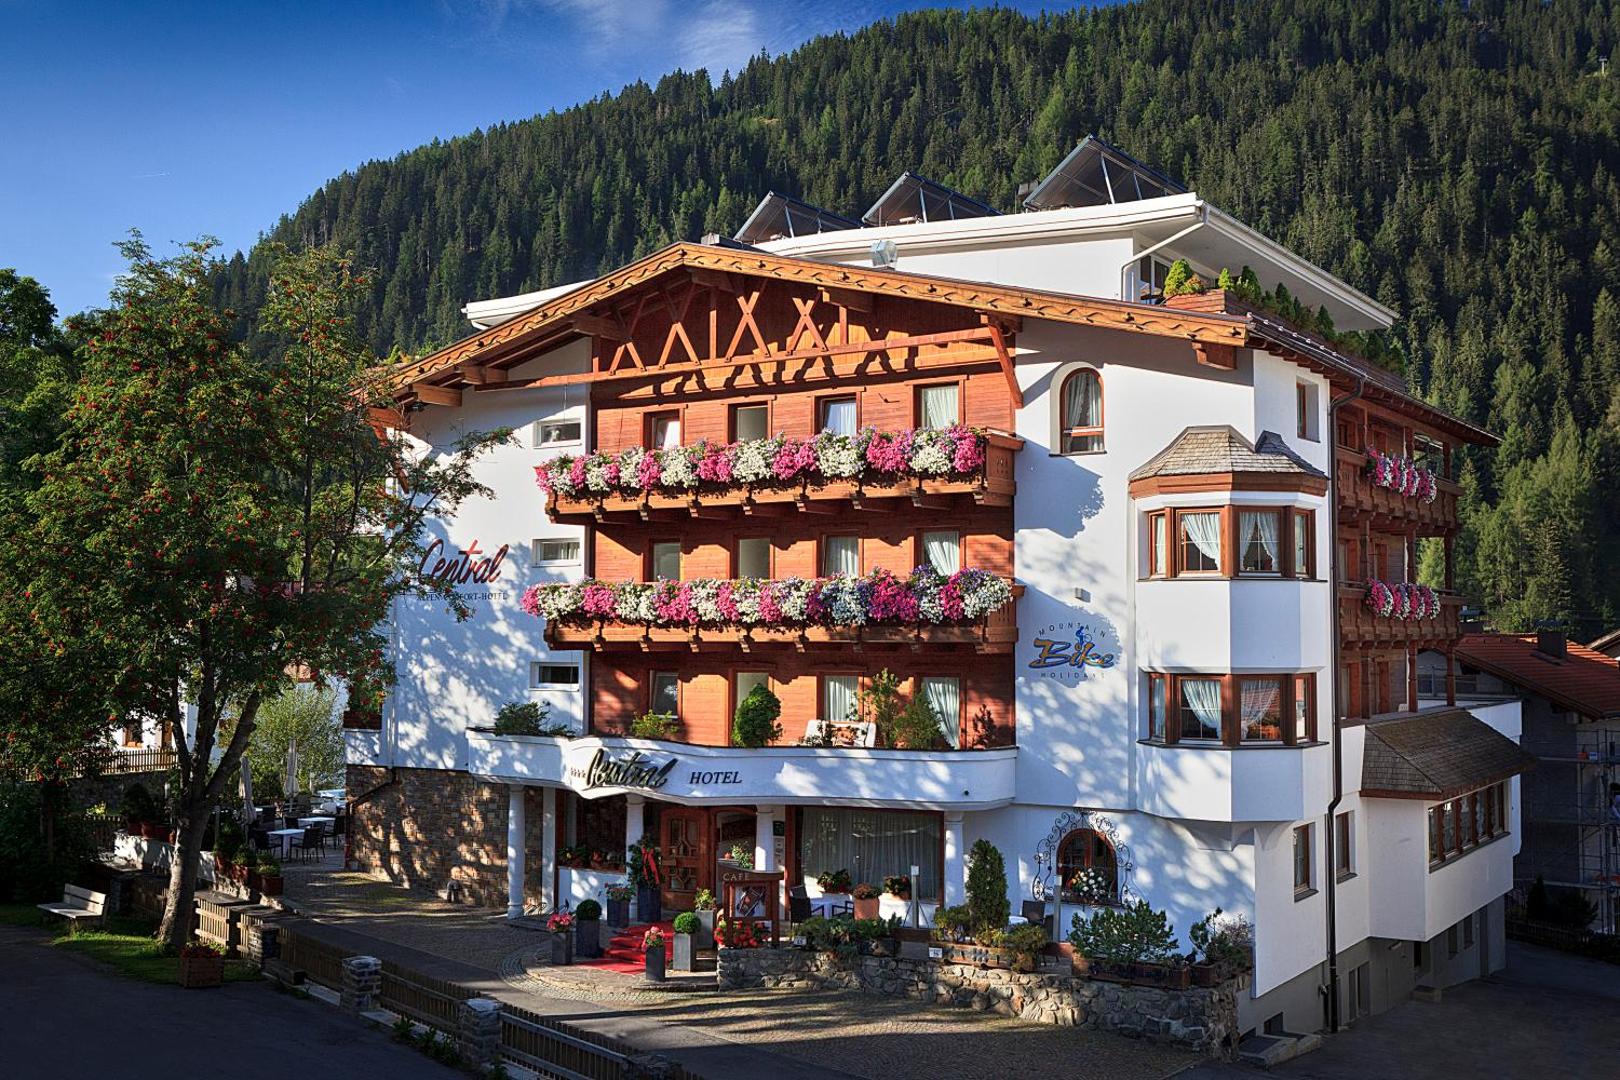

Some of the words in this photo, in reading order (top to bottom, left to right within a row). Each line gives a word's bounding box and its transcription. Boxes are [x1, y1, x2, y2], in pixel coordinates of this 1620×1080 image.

[419, 539, 509, 584] Central
[1039, 622, 1105, 638] MOUNTAIN
[1028, 637, 1115, 669] Bike
[585, 749, 678, 788] Central
[690, 771, 742, 785] HOTEL
